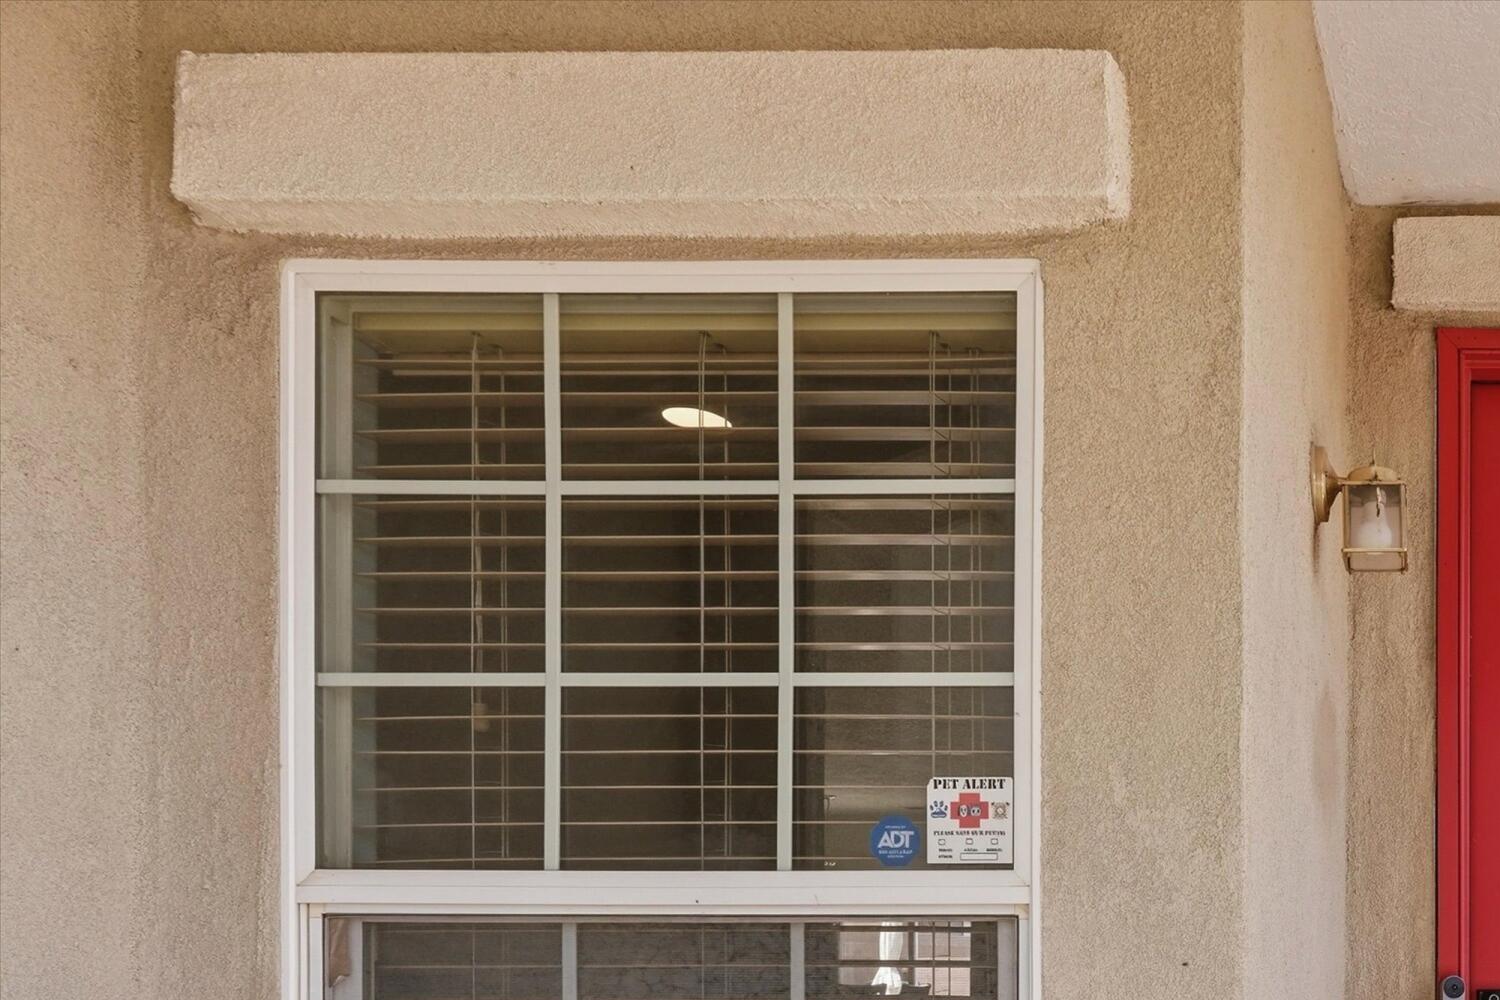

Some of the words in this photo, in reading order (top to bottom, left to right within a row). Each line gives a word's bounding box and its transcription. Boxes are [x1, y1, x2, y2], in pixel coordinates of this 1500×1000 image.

[933, 778, 959, 789] PET
[962, 778, 1006, 789] ALERT
[877, 830, 915, 848] ADT
